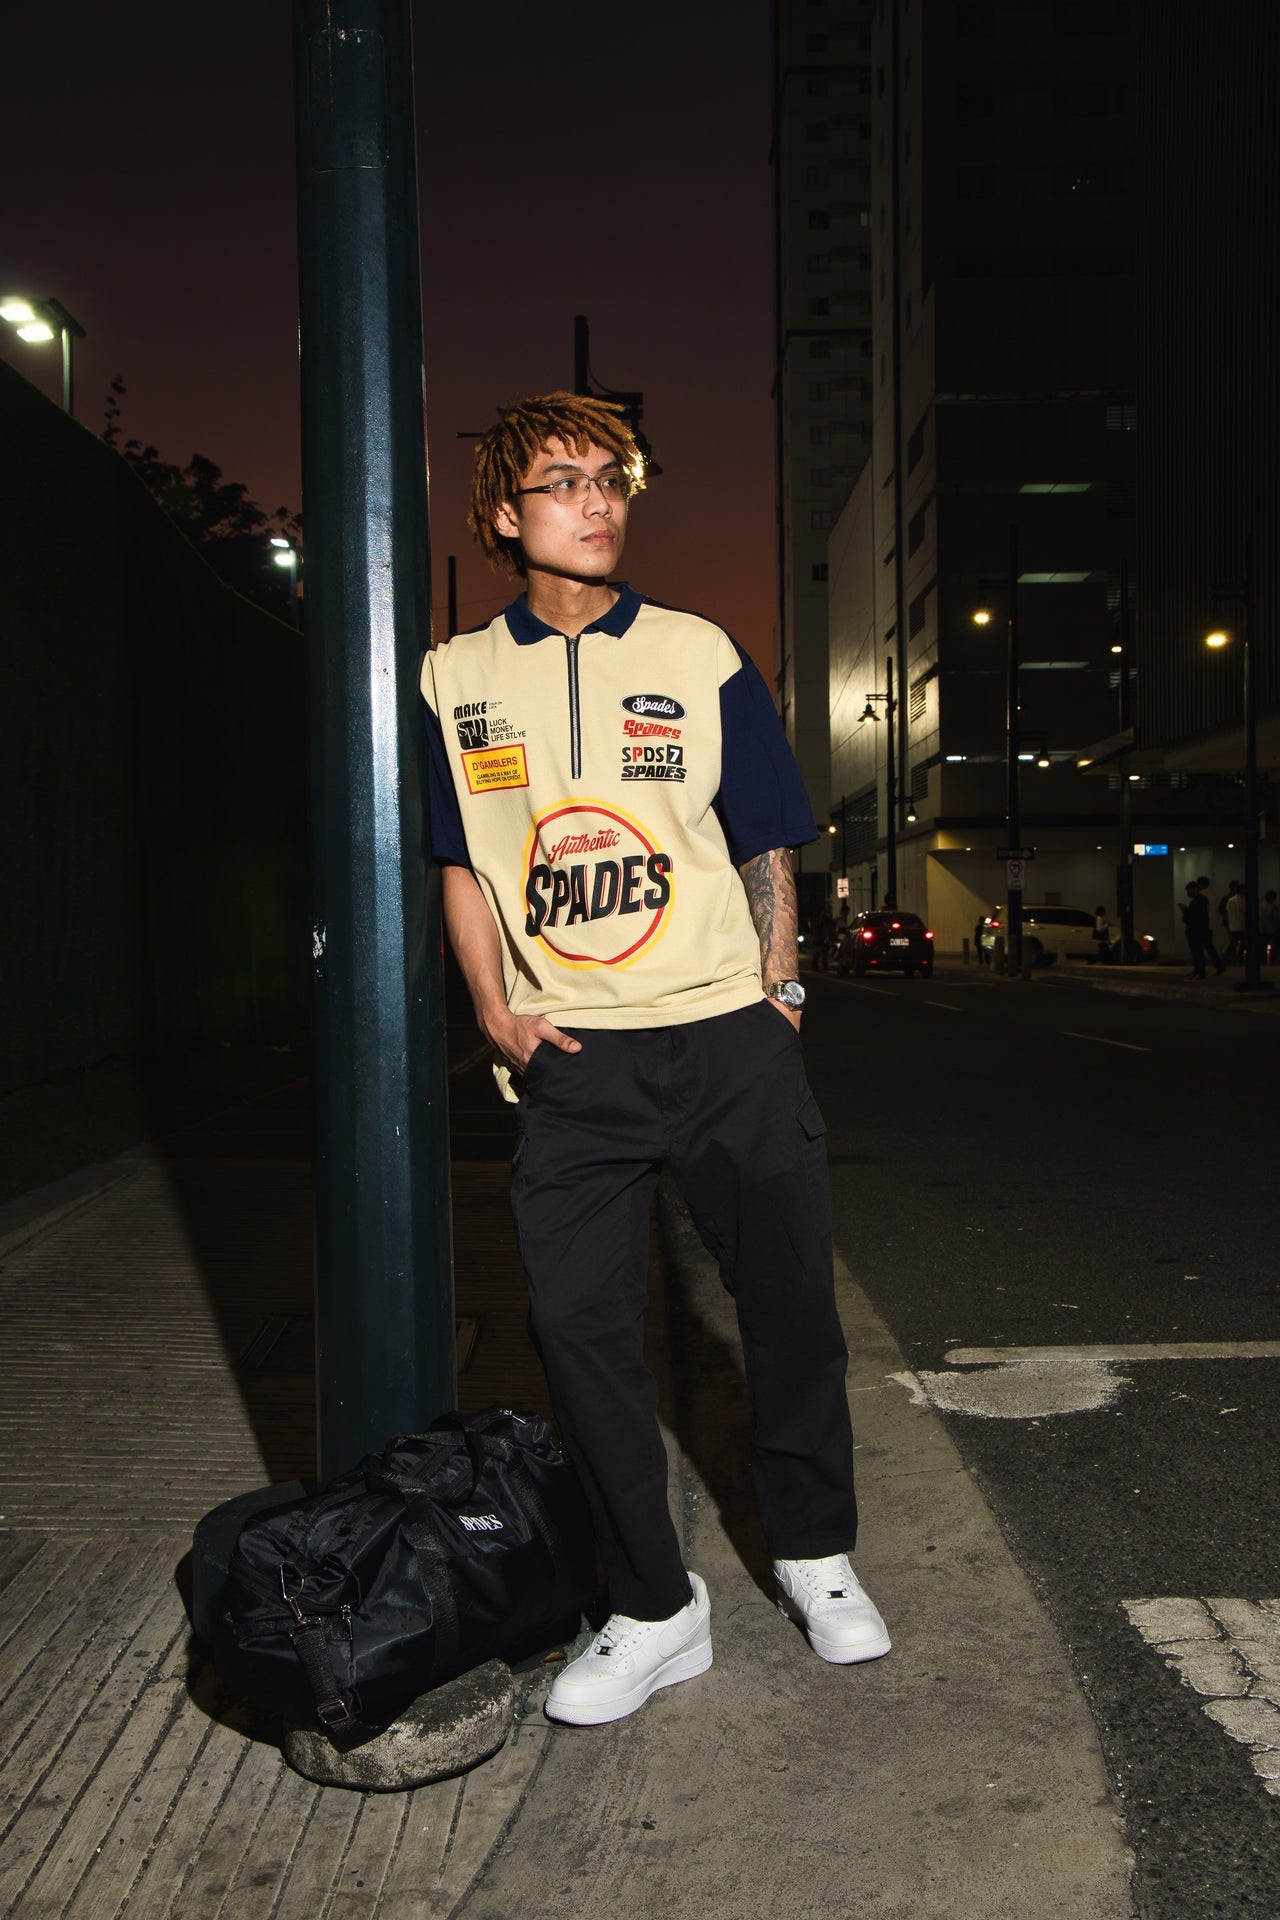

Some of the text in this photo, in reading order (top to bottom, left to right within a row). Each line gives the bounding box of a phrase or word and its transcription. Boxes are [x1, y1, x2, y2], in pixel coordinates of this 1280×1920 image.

[454, 701, 487, 720] MAKE
[632, 696, 676, 714] Spades
[490, 718, 508, 727] LUCK
[490, 725, 514, 734] MONEY
[491, 731, 526, 742] LIFE STLYE
[621, 747, 680, 763] SPDS 7
[472, 756, 518, 770] D'GAMBLERS
[621, 765, 687, 779] SPADES
[548, 828, 621, 864] Authentic
[525, 853, 673, 937] SPADES
